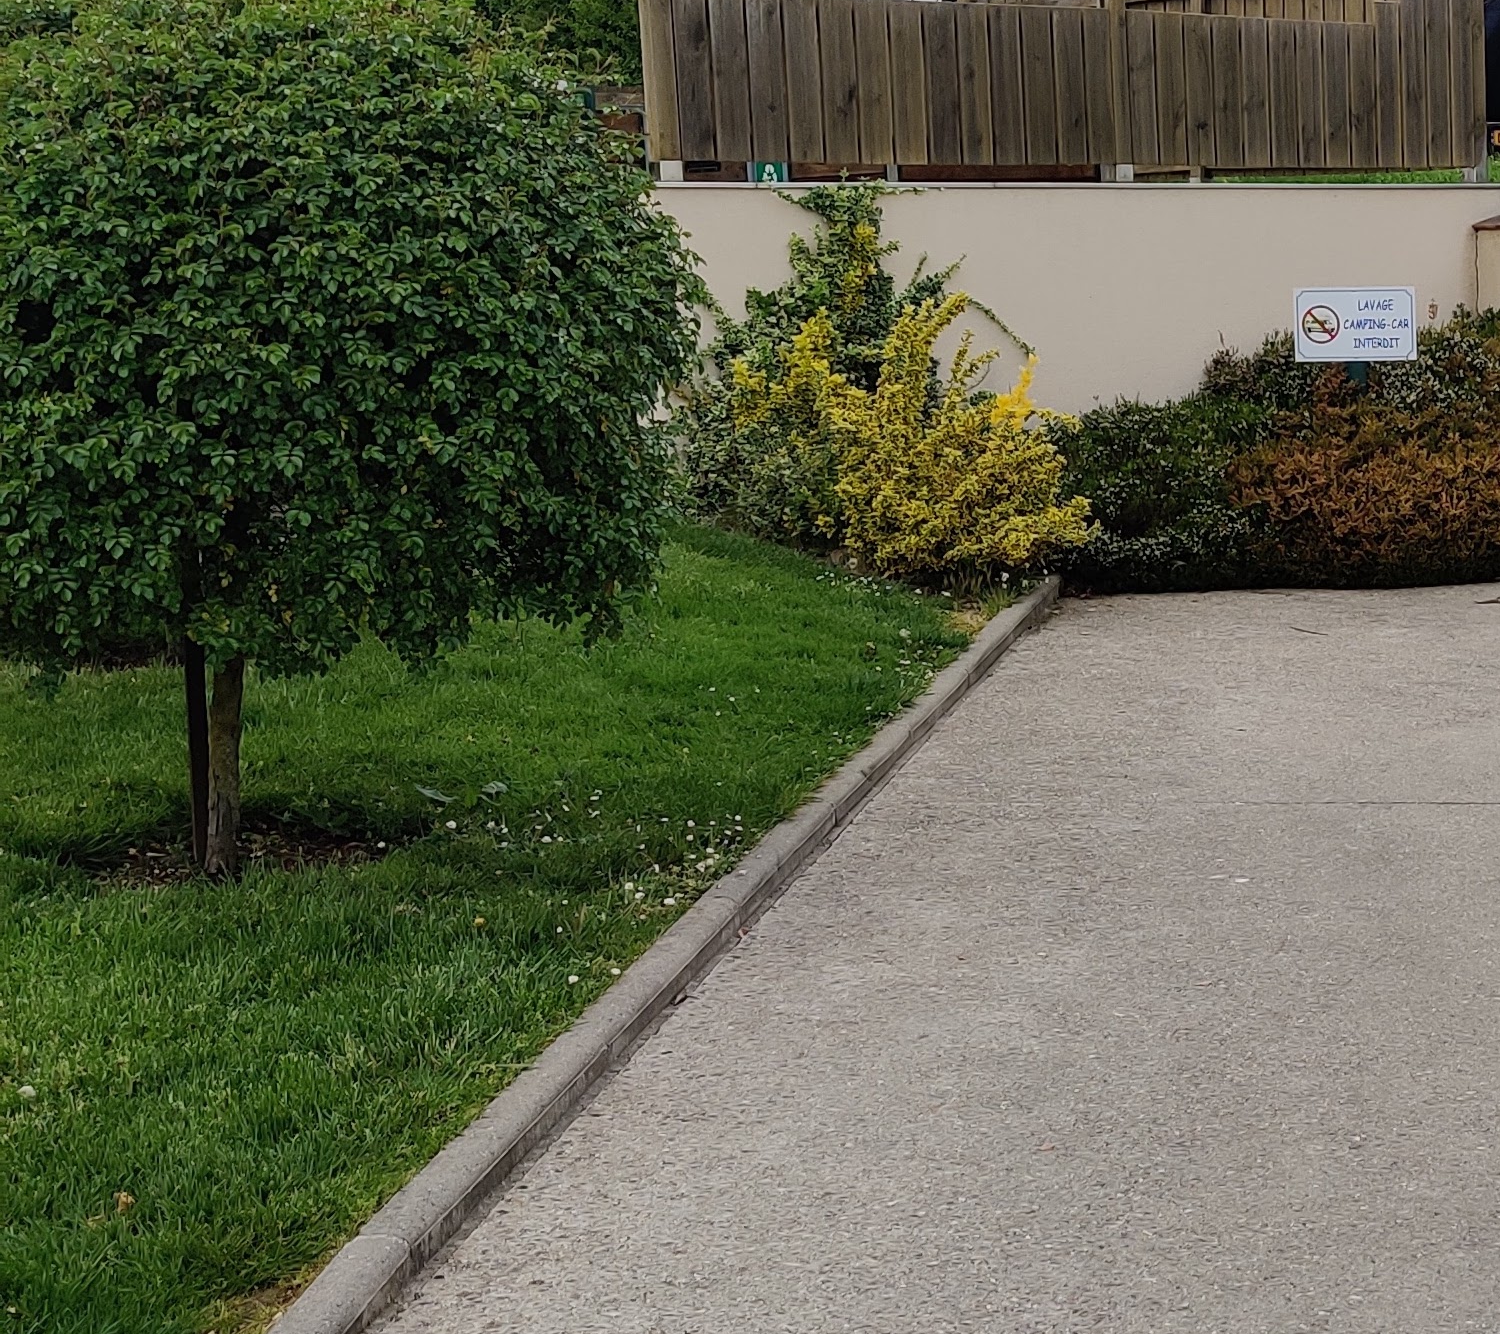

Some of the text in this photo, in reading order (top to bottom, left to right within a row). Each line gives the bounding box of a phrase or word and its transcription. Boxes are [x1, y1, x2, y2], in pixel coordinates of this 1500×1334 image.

[1357, 299, 1394, 311] LAVAGE
[1343, 318, 1410, 330] CAMPING-CAR
[1353, 337, 1400, 349] INTERDIT
